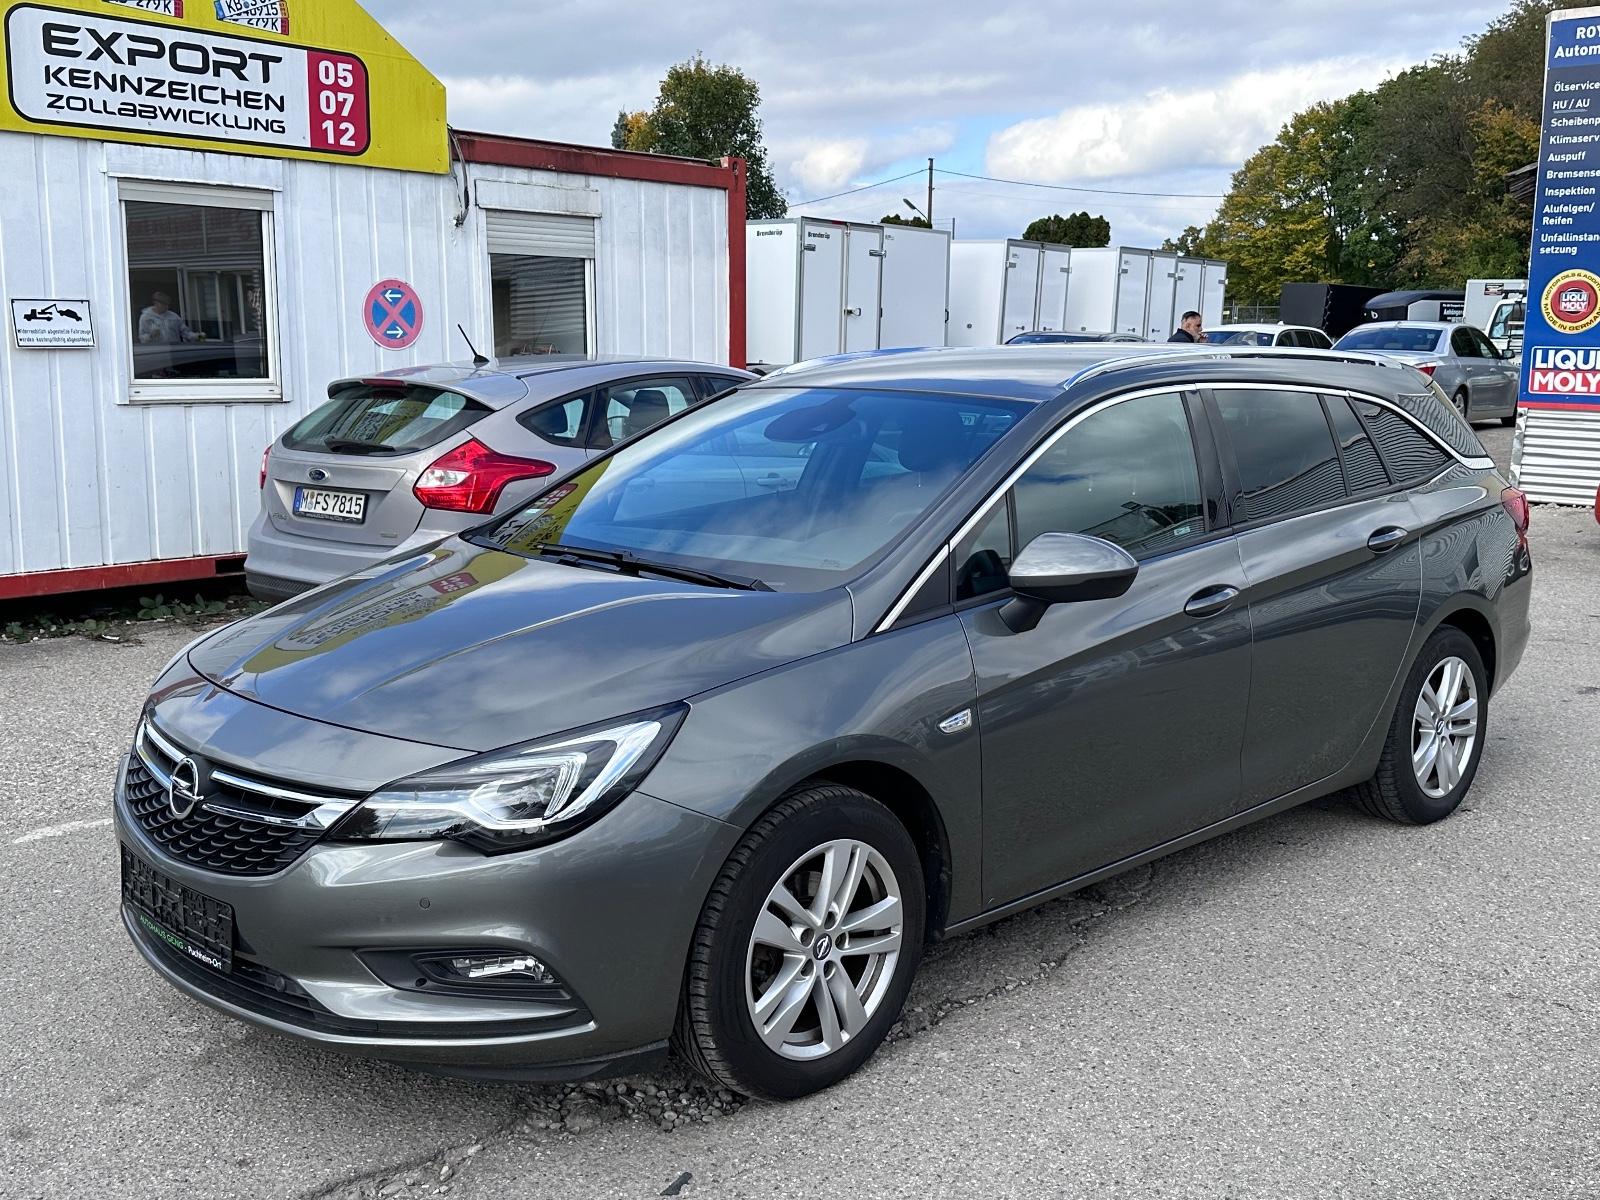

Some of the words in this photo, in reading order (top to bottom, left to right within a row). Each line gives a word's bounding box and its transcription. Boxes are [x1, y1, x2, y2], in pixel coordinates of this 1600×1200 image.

[42, 22, 283, 84] EXPORT
[318, 60, 354, 88] 05
[44, 65, 285, 113] KENNZEICHEN
[1554, 80, 1600, 92] Ölservice
[319, 90, 355, 117] 07
[1552, 100, 1568, 110] HU
[1575, 98, 1591, 108] AU
[321, 119, 356, 147] 12
[1547, 150, 1586, 163] Auspuff
[1544, 186, 1596, 198] Inspektion
[1542, 202, 1596, 215] Alufelgen/
[1542, 216, 1573, 226] Reifen
[1539, 245, 1578, 256] setzung
[1561, 301, 1588, 310] MOLY
[1562, 293, 1588, 302] LIQUI
[1543, 303, 1559, 326] MADE
[1557, 323, 1568, 331] IN
[1534, 349, 1600, 371] LIQUI
[1532, 371, 1600, 393] MOLY
[139, 914, 167, 939] AUTOHAUS
